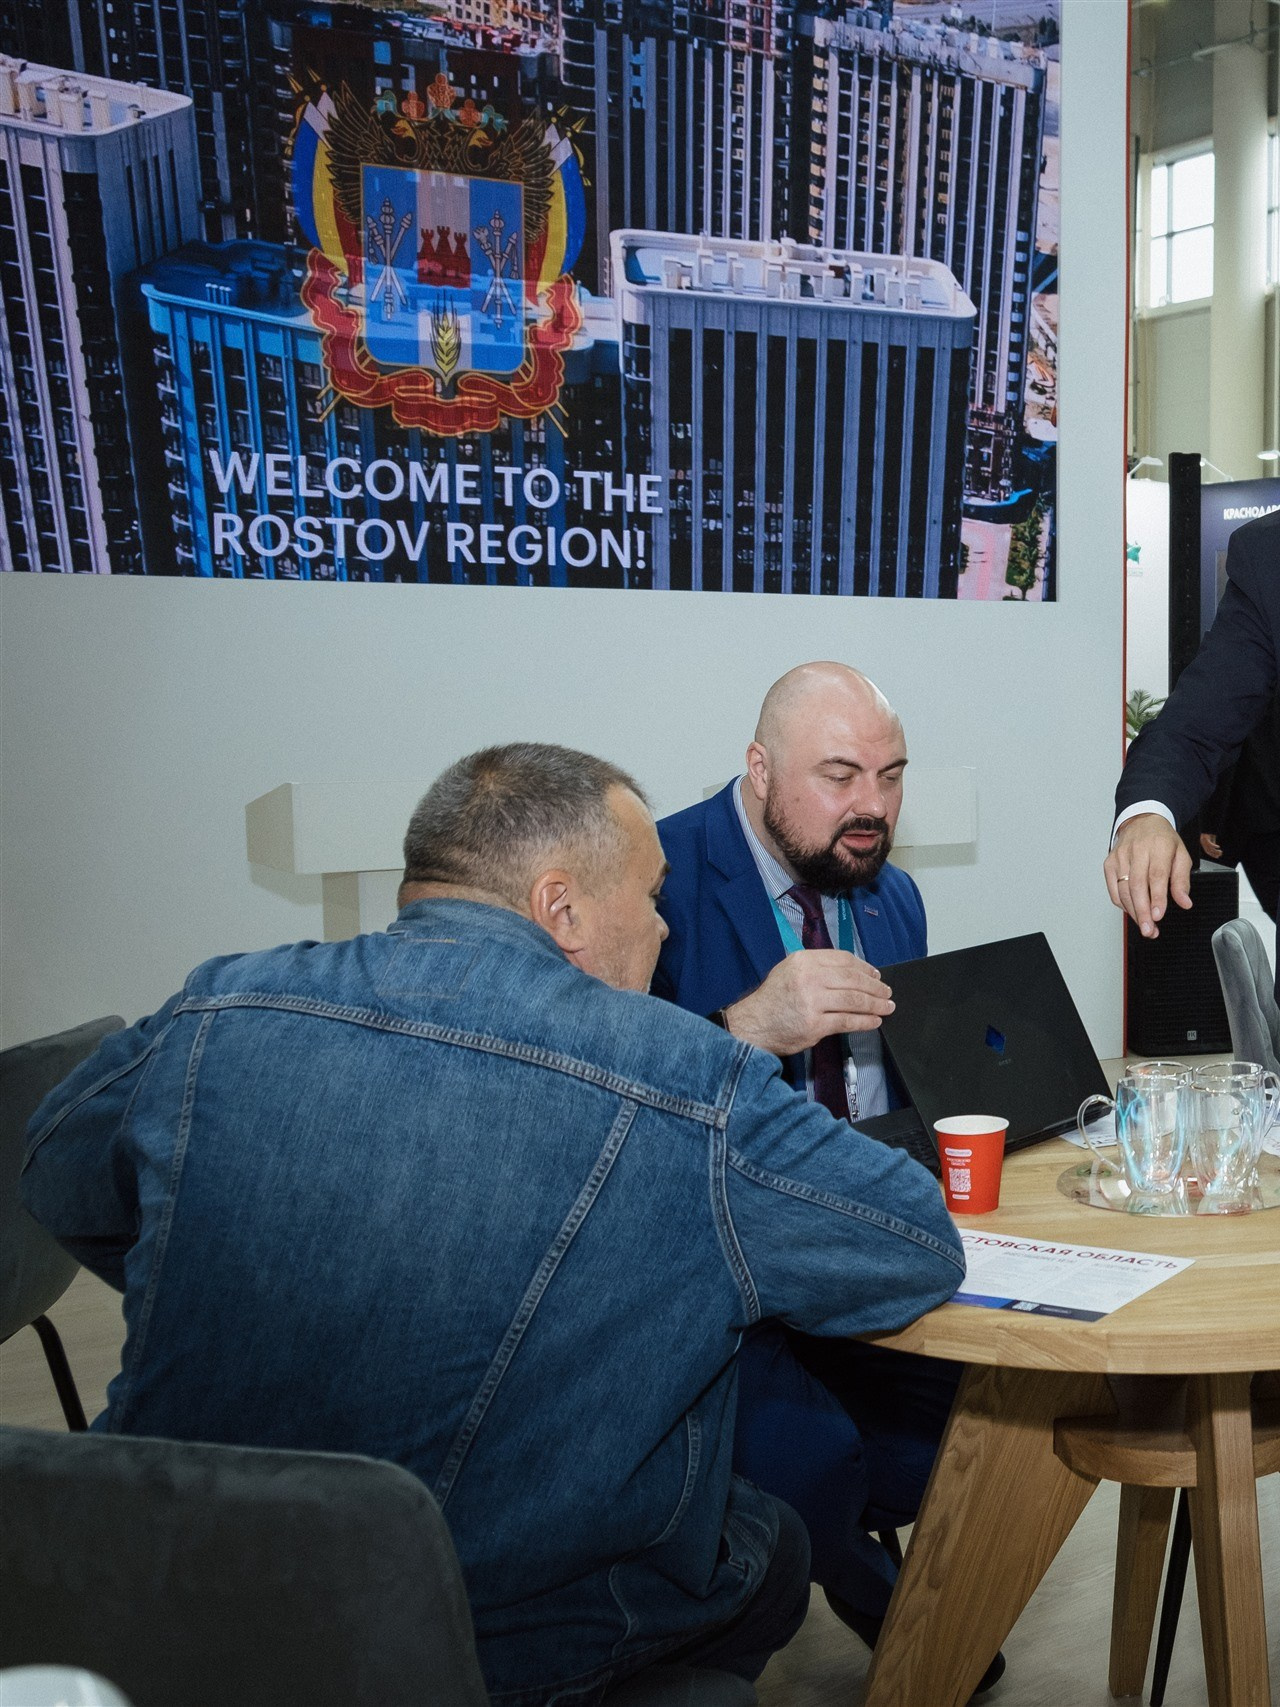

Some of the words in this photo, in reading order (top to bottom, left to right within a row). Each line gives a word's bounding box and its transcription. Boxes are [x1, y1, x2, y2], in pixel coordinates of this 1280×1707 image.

[210, 450, 482, 505] WELCOME
[494, 466, 560, 510] TO
[573, 469, 664, 515] THE
[213, 511, 430, 563] ROSTOV
[446, 522, 647, 569] REGION!
[961, 1235, 1069, 1256] СТОВСКАЯ
[1076, 1251, 1179, 1270] ОБЛАСТЬ
